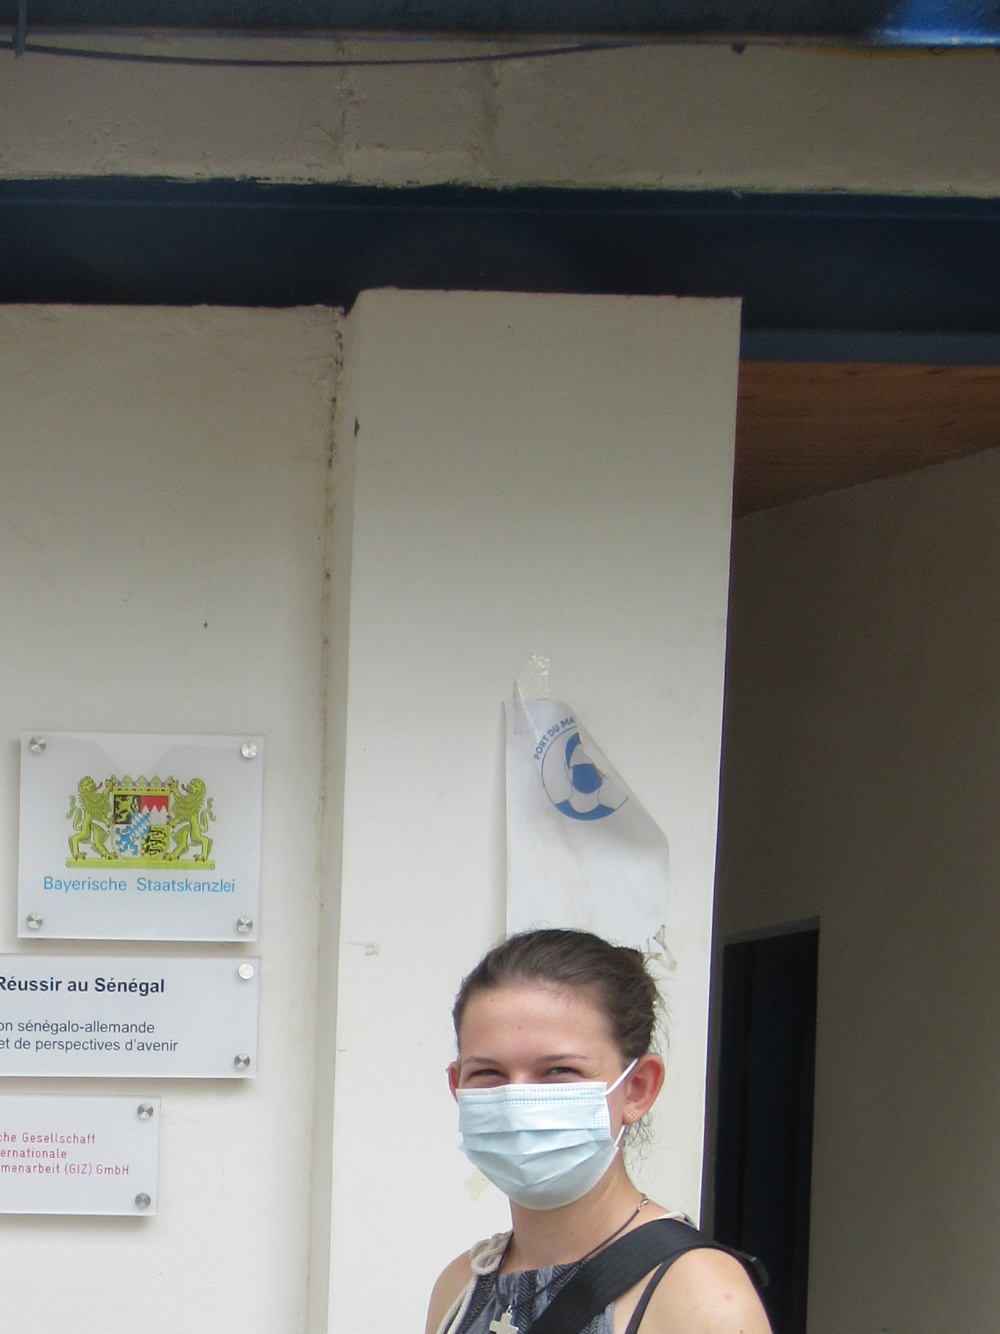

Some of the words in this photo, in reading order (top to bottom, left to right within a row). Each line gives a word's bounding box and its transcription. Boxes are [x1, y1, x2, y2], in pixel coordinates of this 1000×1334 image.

[534, 734, 549, 760] PORT
[547, 723, 560, 737] DU
[560, 716, 576, 728] MA
[44, 876, 126, 893] Bayerische
[137, 877, 234, 892] Staatskanzlei
[66, 980, 89, 992] au
[95, 978, 164, 996] Sénégal
[18, 1020, 154, 1035] sénégalo-allemande
[14, 1038, 30, 1049] de
[36, 1039, 120, 1053] perspectives
[125, 1039, 178, 1051] d'avenir
[22, 1132, 95, 1144] Gesellschaft
[65, 1163, 92, 1175] (GIZ)
[97, 1164, 129, 1175] GmbH
